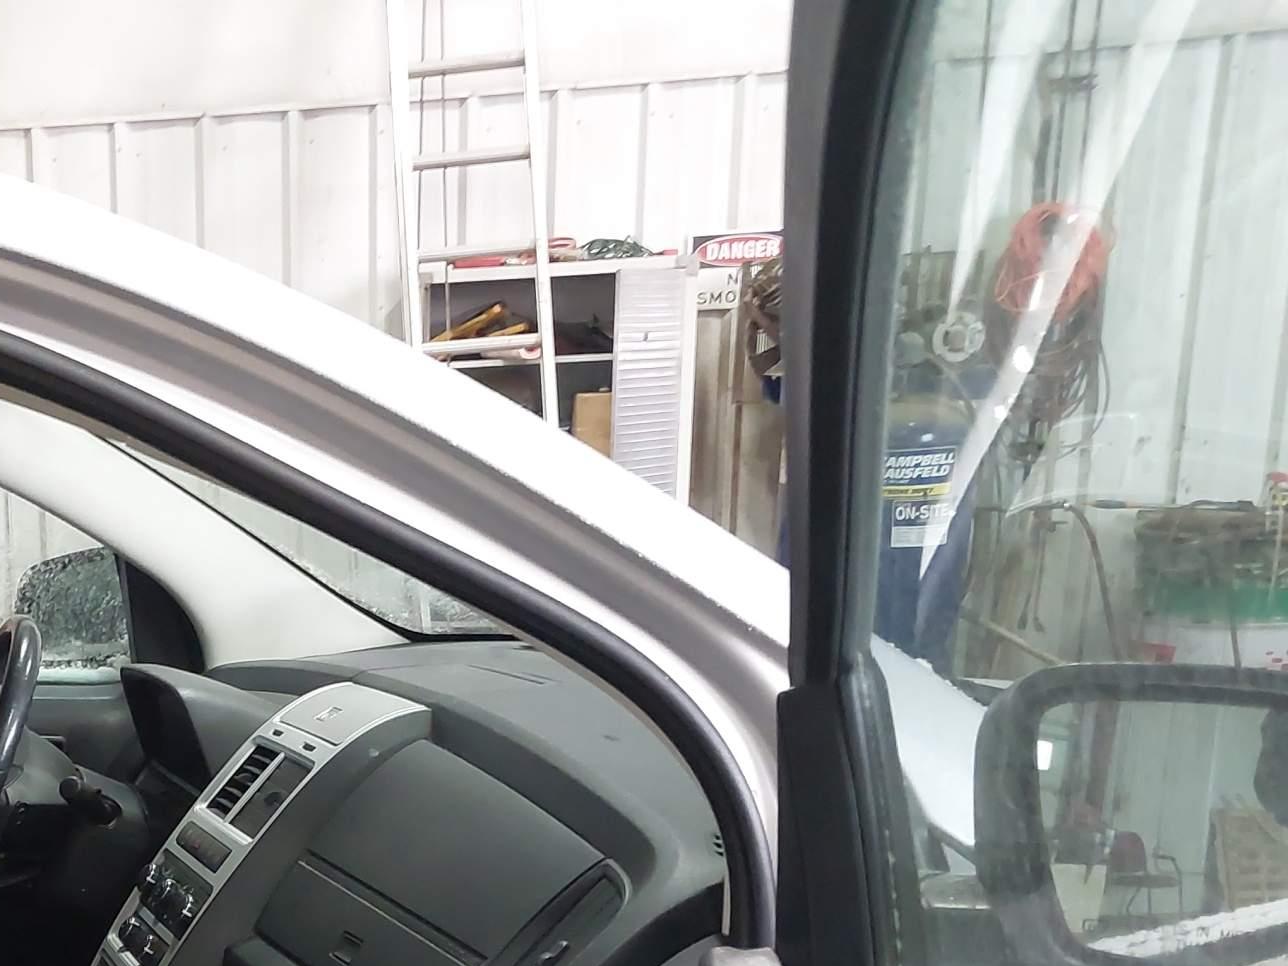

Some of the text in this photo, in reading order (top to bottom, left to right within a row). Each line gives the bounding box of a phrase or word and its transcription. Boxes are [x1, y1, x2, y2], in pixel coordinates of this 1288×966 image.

[706, 239, 780, 260] DANGER
[883, 452, 954, 468] AMPBELL
[882, 464, 950, 480] AUSFELD
